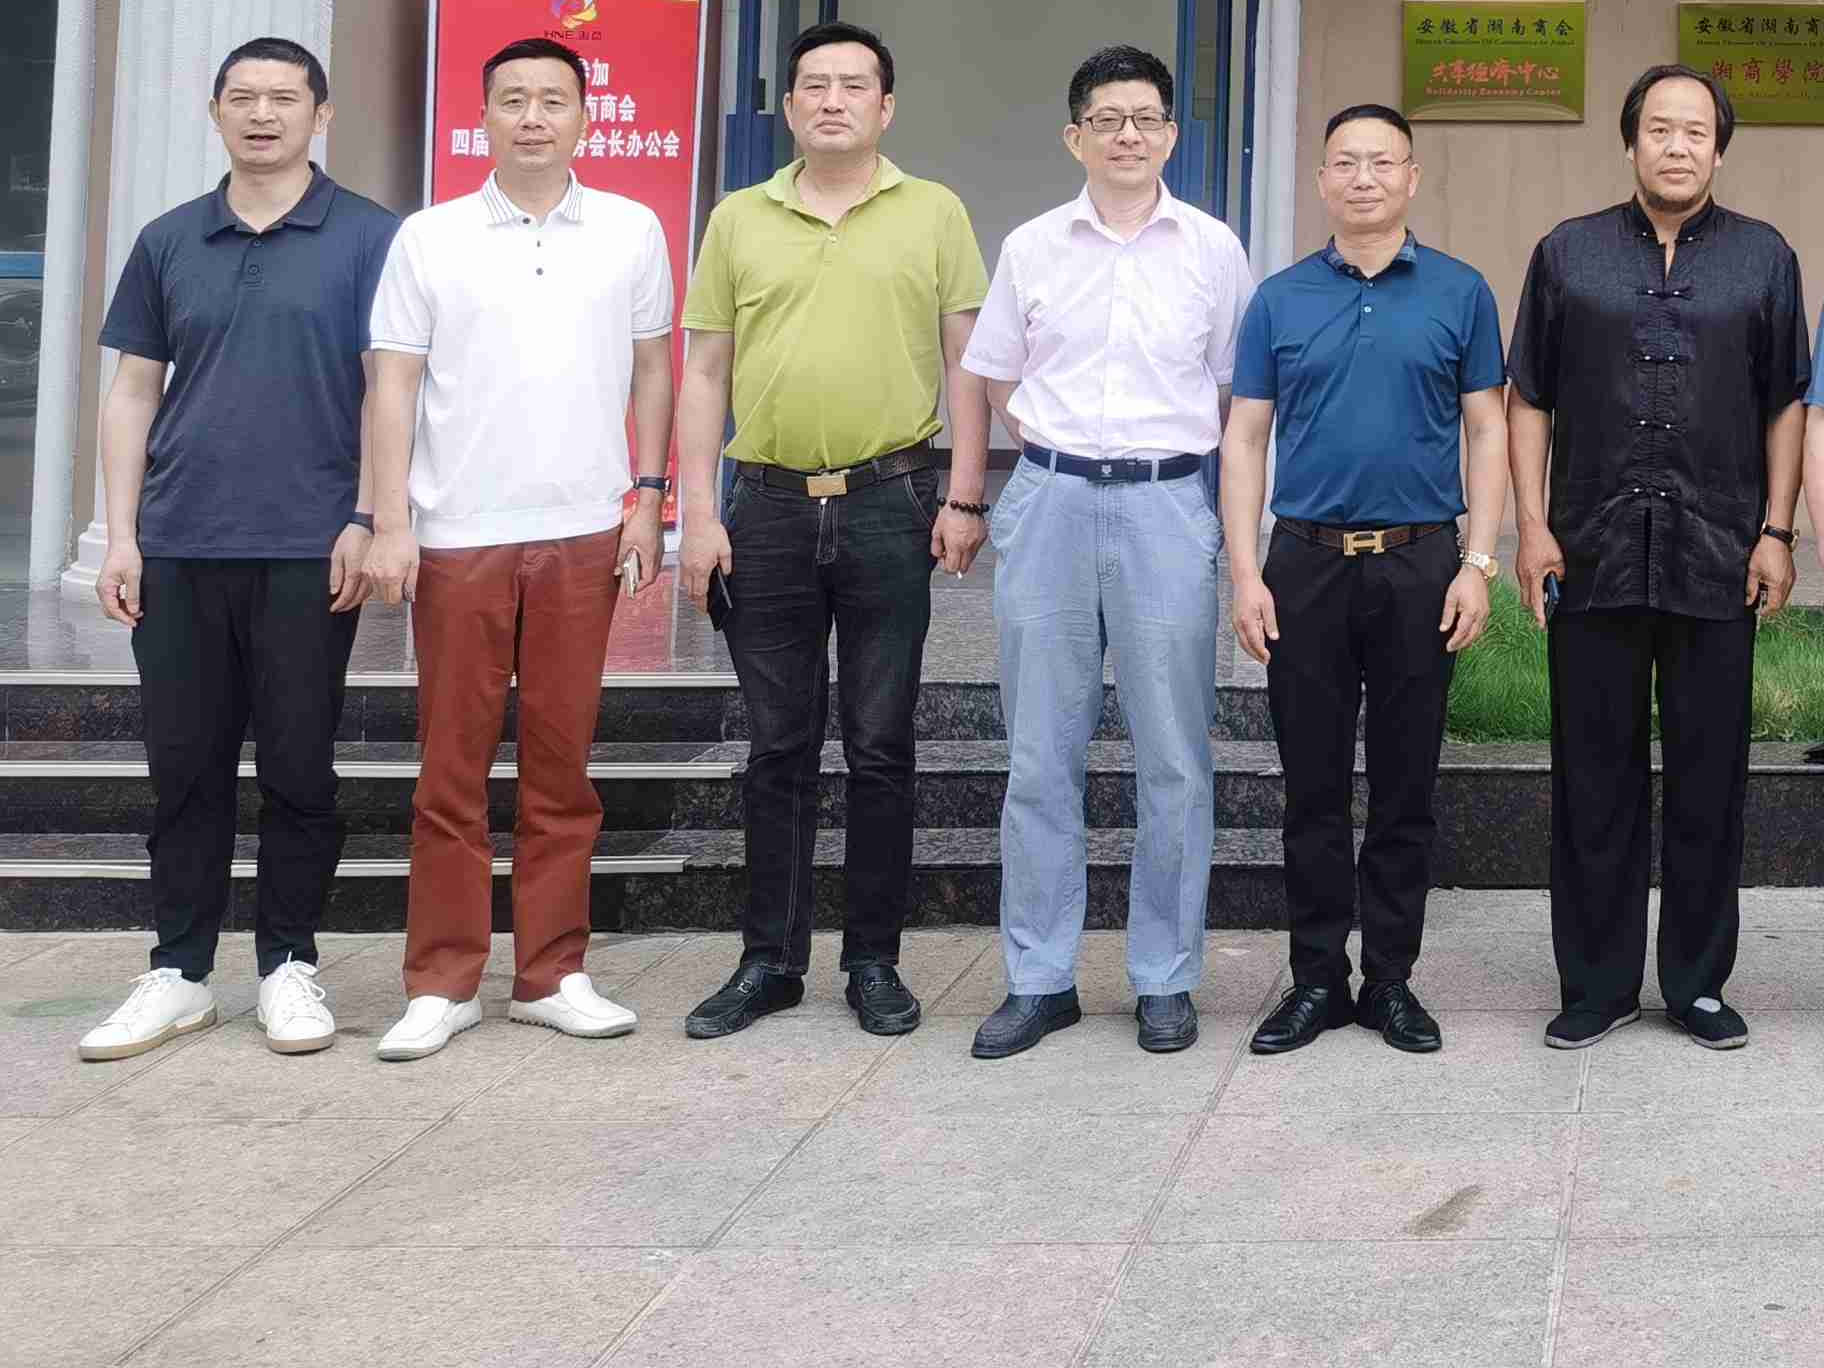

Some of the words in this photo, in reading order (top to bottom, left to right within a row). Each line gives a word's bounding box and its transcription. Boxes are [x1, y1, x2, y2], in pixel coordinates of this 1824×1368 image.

[1416, 16, 1575, 37] 安徽省湖南商会
